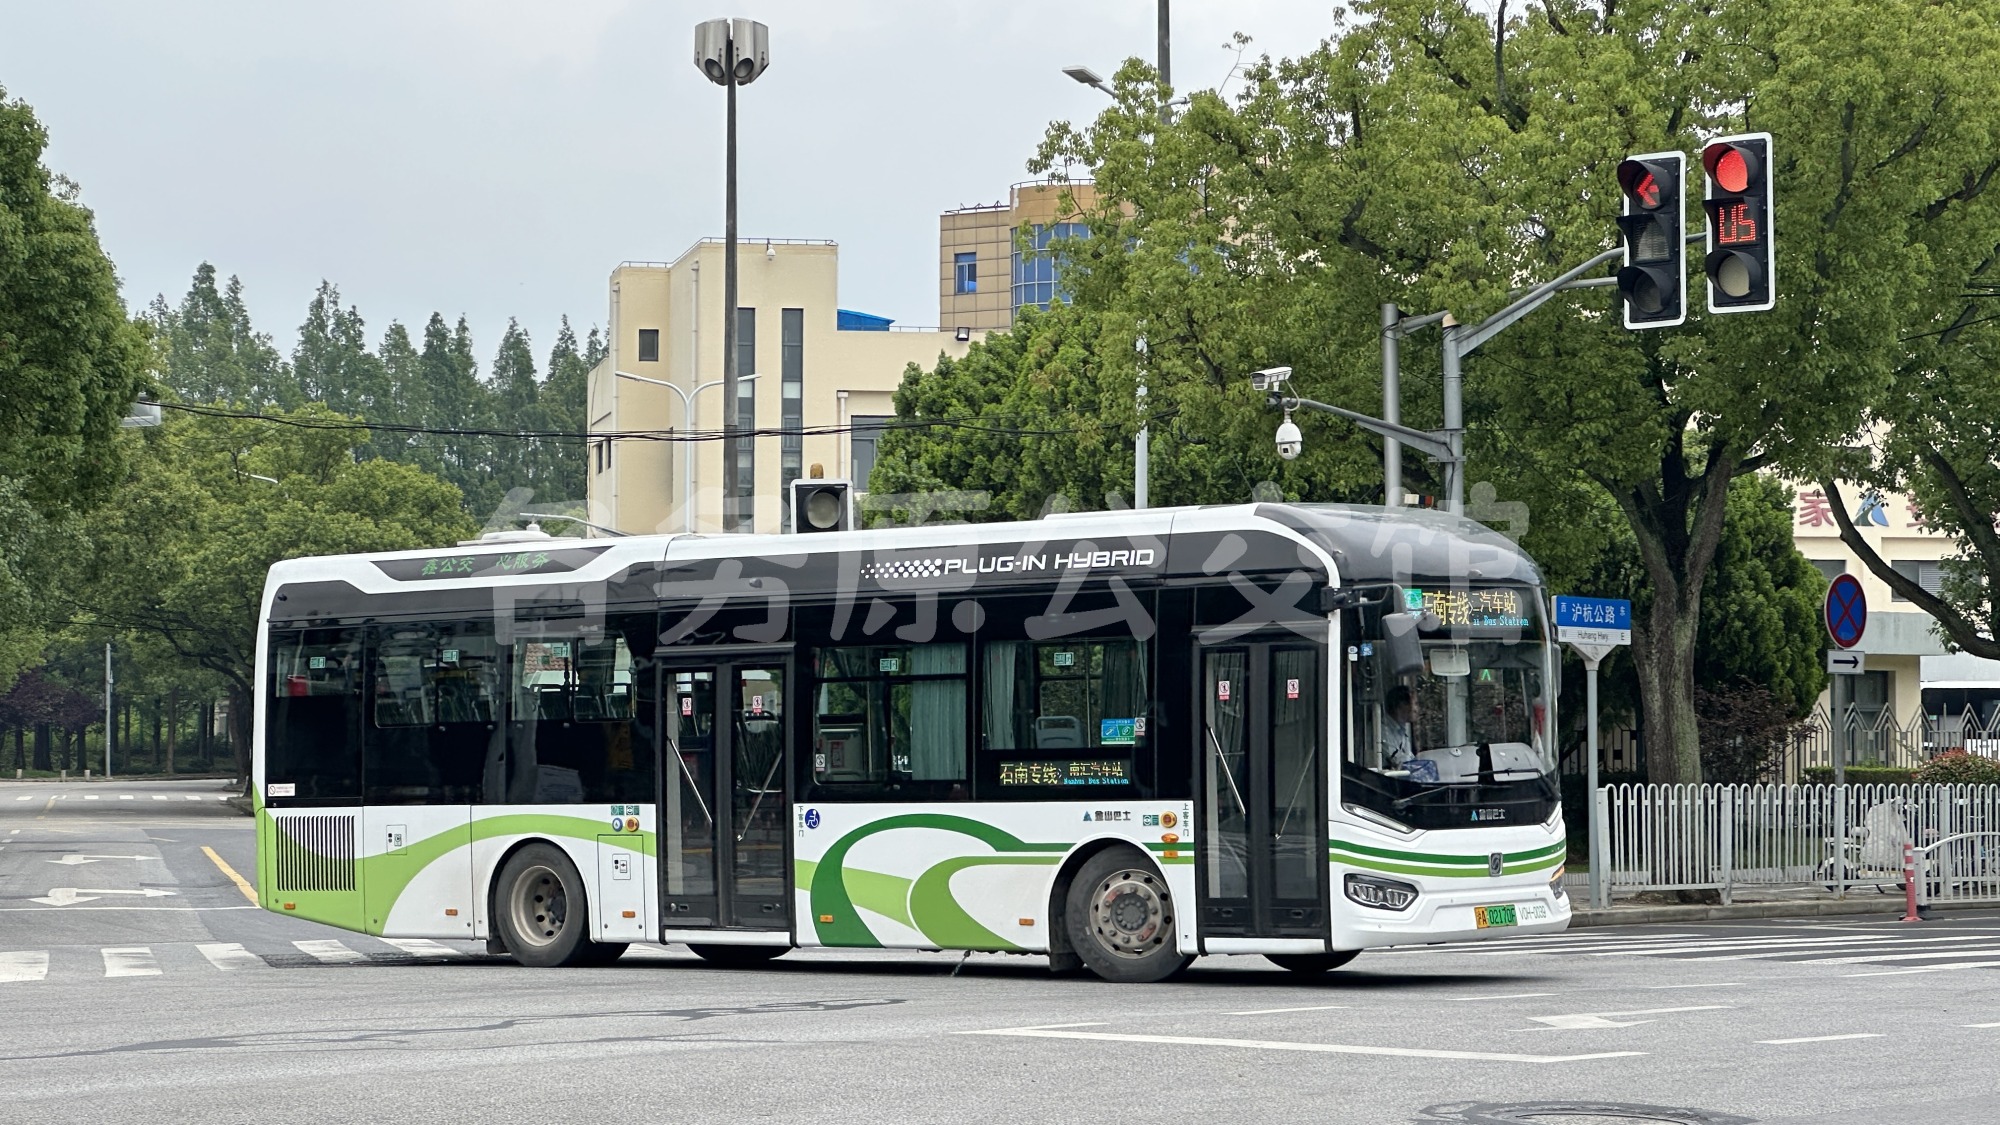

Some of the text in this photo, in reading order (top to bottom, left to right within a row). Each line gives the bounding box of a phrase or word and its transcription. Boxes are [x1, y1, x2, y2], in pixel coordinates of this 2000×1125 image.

[944, 548, 1155, 575] PLUG-IN HYBRID
[1484, 615, 1496, 626] Bus
[1500, 615, 1529, 626] Station
[1571, 603, 1615, 624] 沪杭公路
[1620, 632, 1625, 640] E
[1000, 762, 1058, 785] 石南专线
[1069, 761, 1123, 777] 南汇汽车站
[1088, 777, 1100, 785] Bus
[1102, 777, 1129, 785] Station
[1094, 810, 1131, 821] 金山巴士
[1182, 803, 1190, 837] 上客车门
